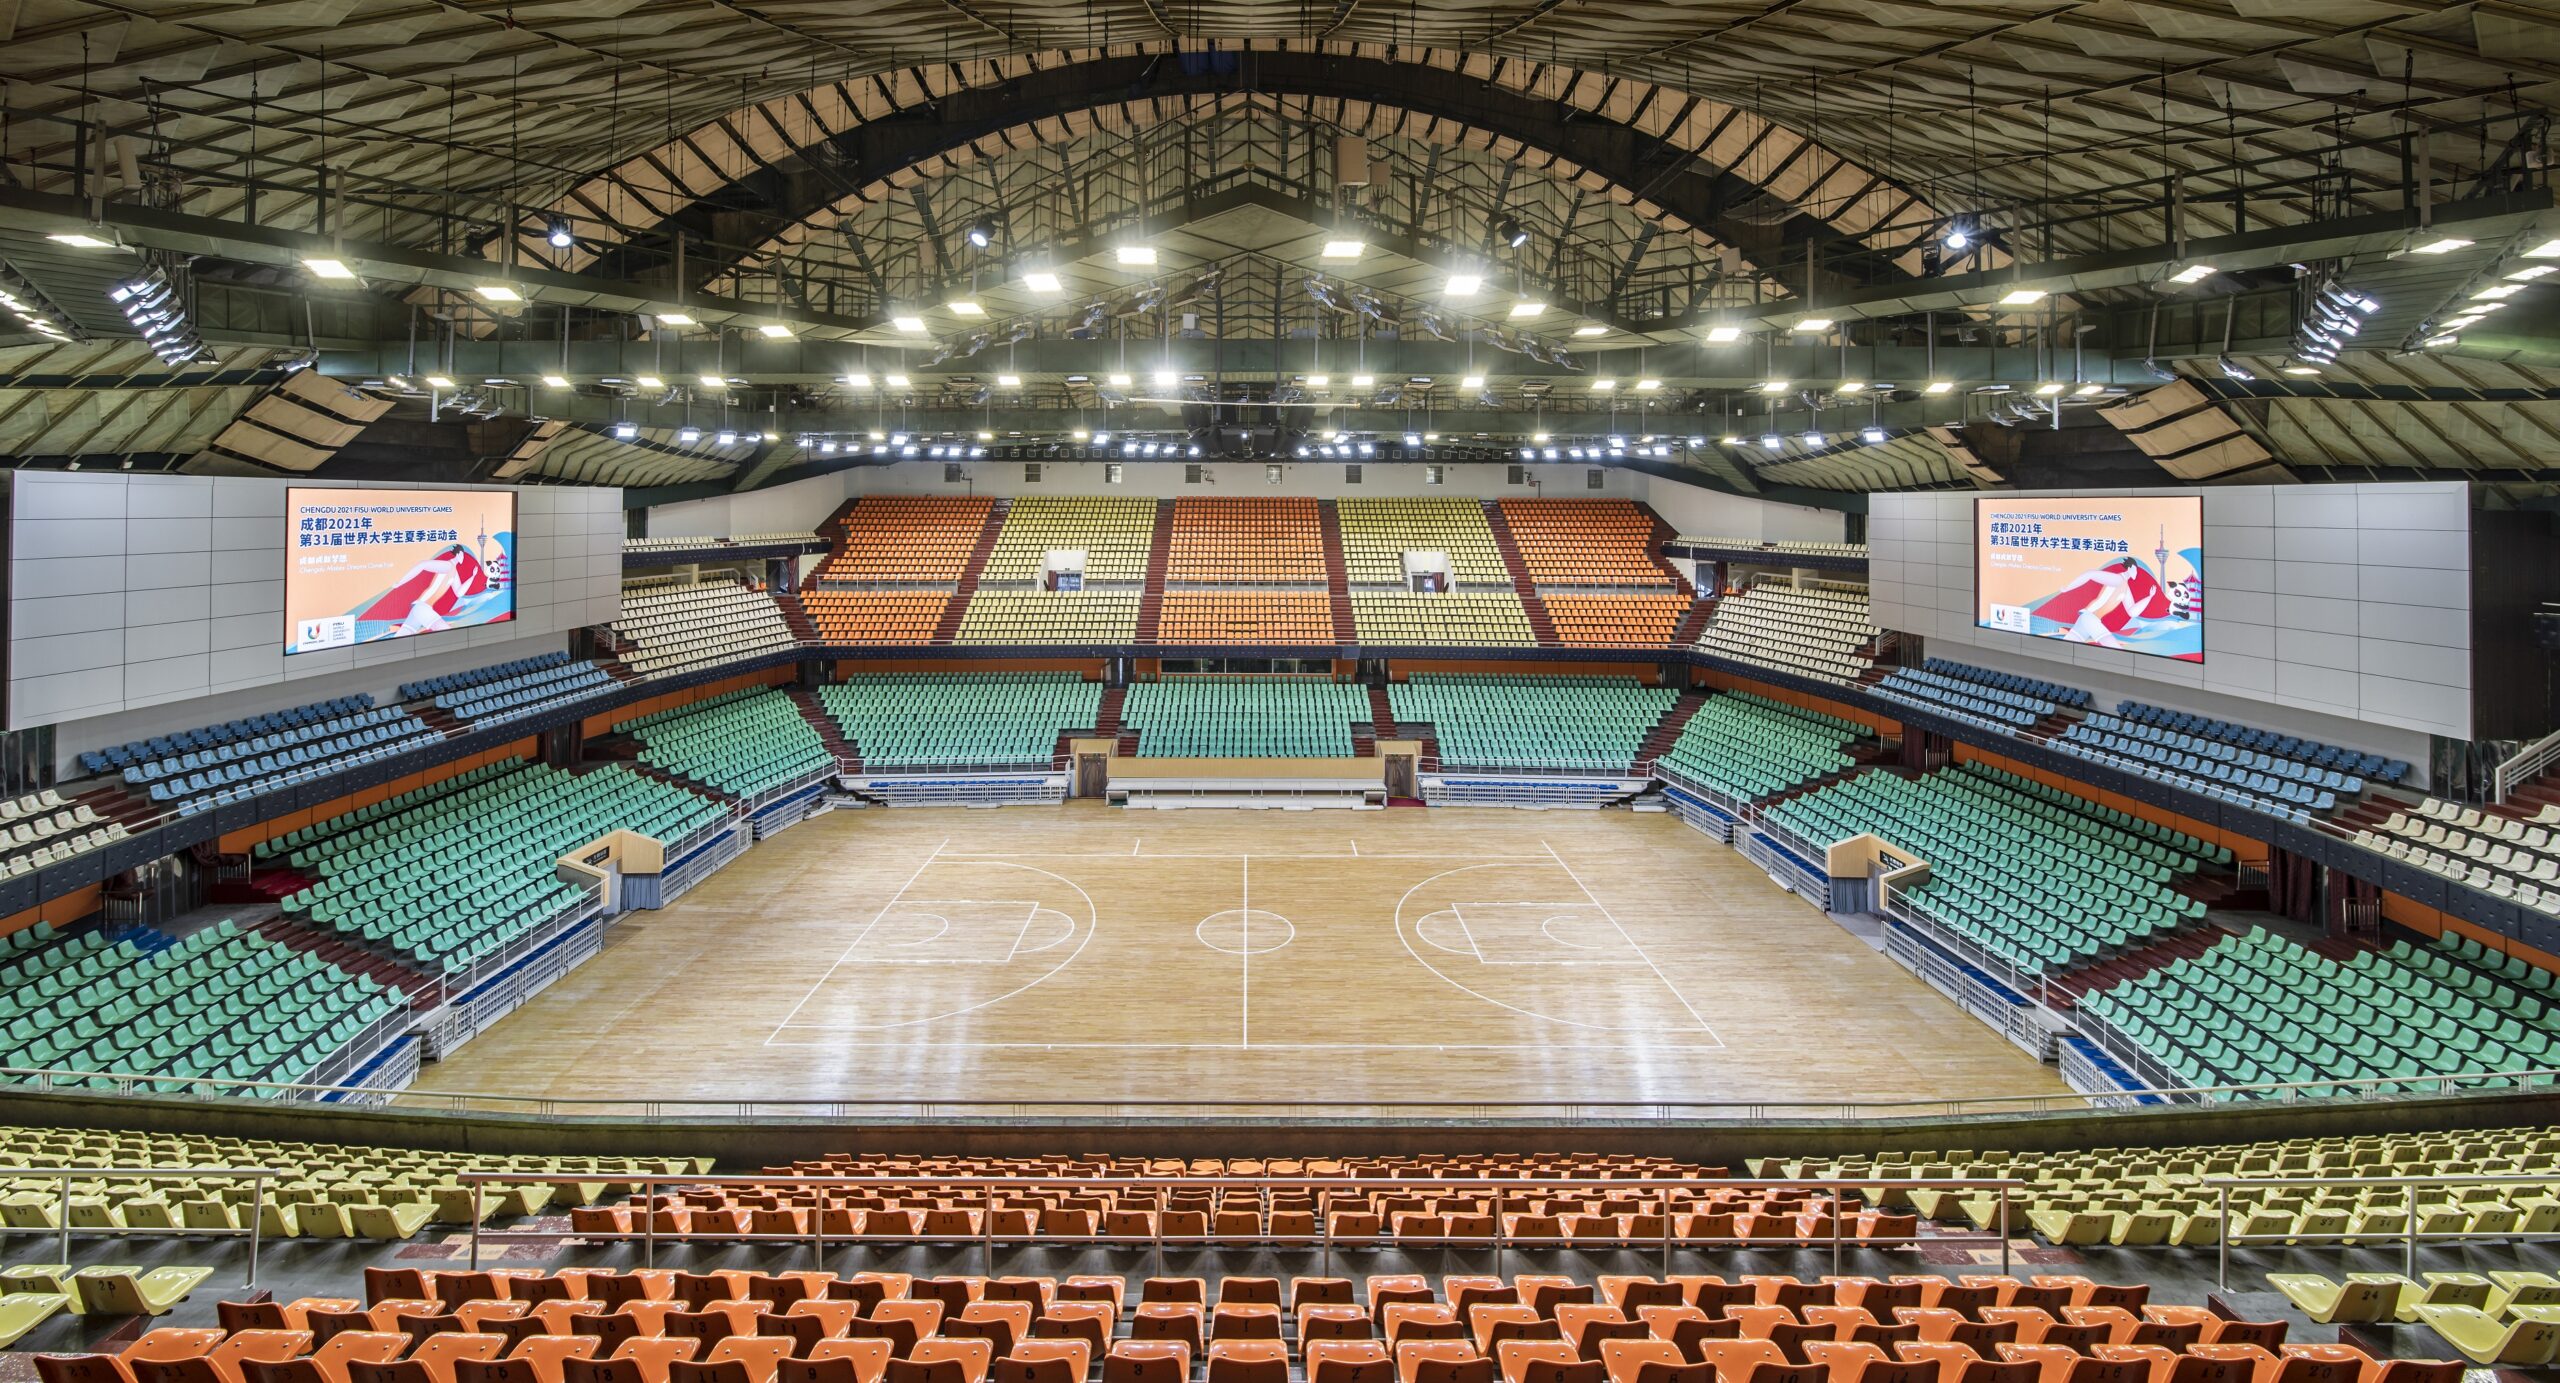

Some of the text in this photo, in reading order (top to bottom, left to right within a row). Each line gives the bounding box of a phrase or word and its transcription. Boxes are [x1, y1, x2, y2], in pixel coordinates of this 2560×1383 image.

[300, 506, 336, 514] CHENGDU
[300, 517, 373, 531] 成都2021年
[1991, 522, 2043, 534] 成都2021年
[299, 529, 458, 547] 第31届世界大学生夏季运动会
[1990, 535, 2129, 552] 第31届世界大学生夏季运动会
[20, 1280, 36, 1290] 27
[1249, 1288, 1253, 1298] 1
[2362, 1290, 2378, 1301] 24
[1159, 1321, 1167, 1331] 3
[1336, 1324, 1343, 1335] 2
[2534, 1330, 2554, 1341] 24
[808, 1367, 816, 1379] 9
[1133, 1364, 1143, 1376] 3
[1352, 1367, 1362, 1379] 2
[1449, 1367, 1457, 1380] 4
[2098, 1366, 2122, 1379] 16
[2202, 1365, 2226, 1379] 18
[2309, 1365, 2331, 1378] 20
[1779, 1374, 1798, 1383] 10
